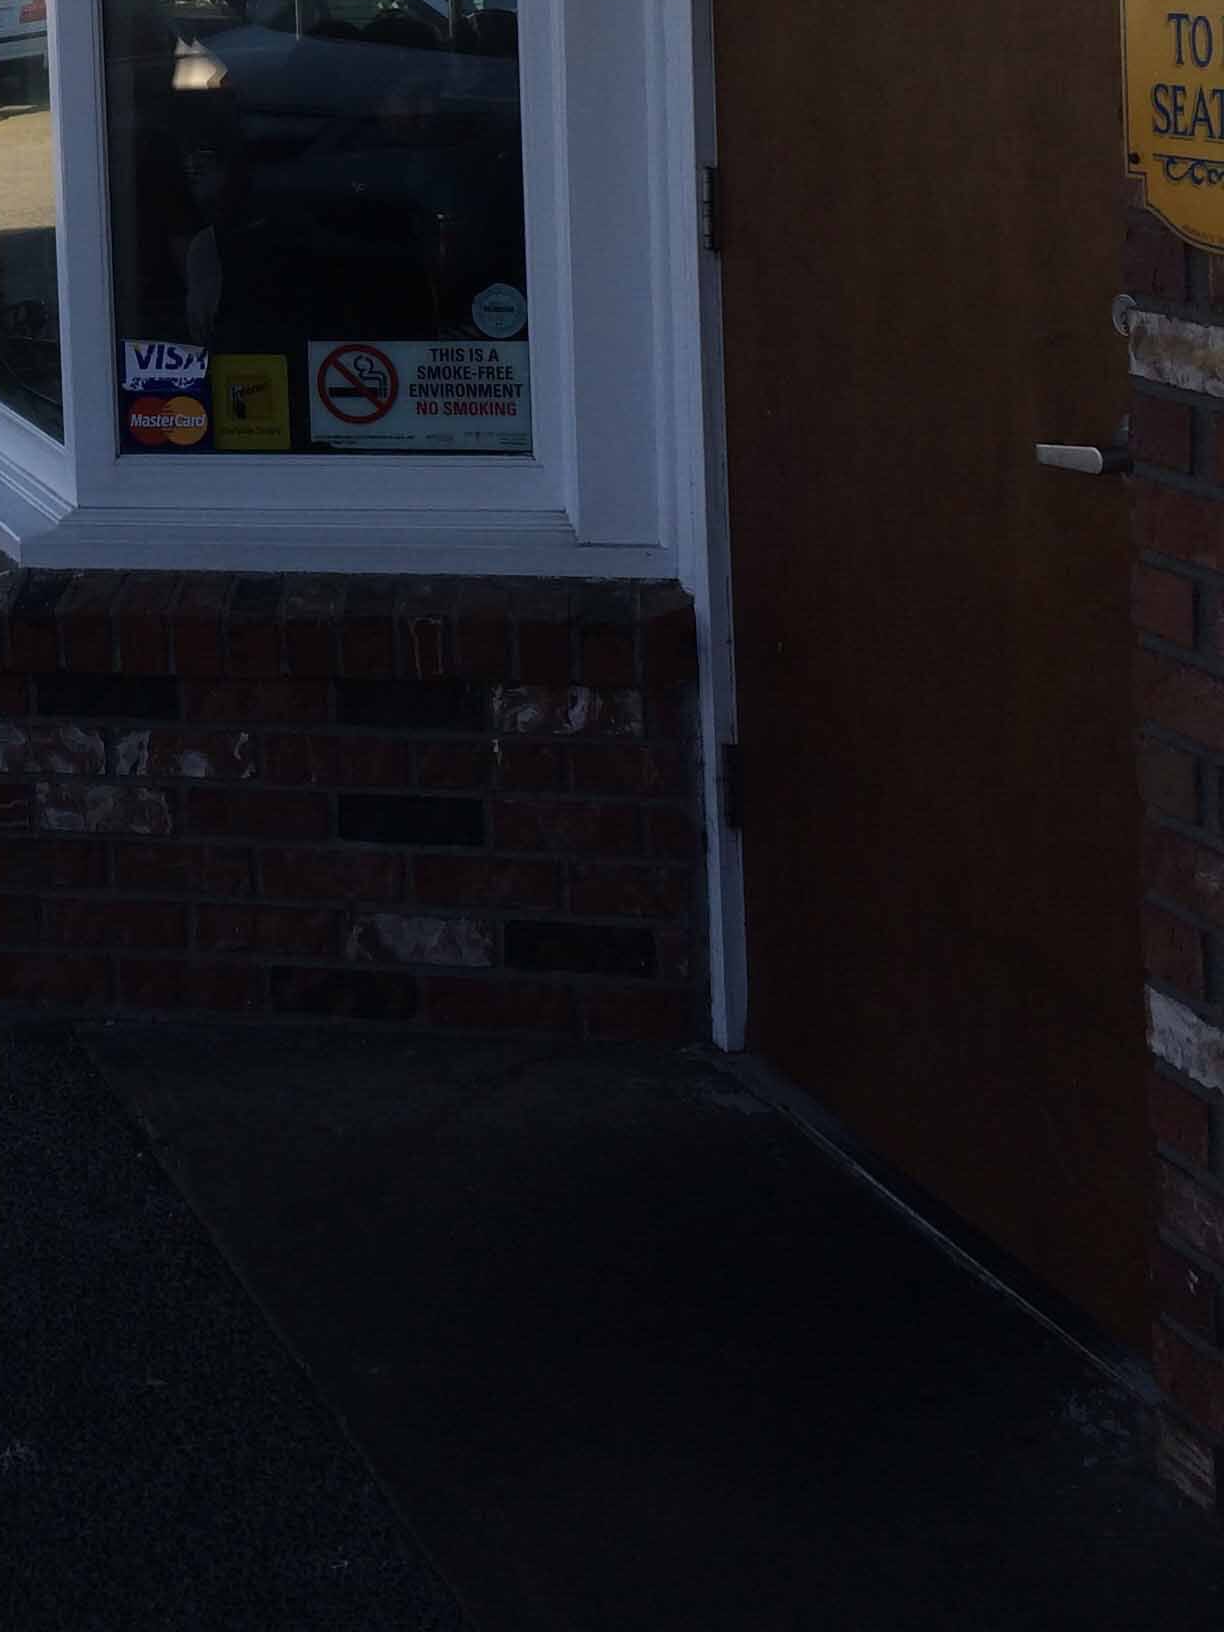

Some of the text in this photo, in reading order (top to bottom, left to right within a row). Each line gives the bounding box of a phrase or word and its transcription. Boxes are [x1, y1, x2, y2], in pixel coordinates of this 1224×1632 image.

[1167, 12, 1214, 68] TO
[134, 343, 208, 370] VISA
[430, 348, 500, 363] THIS IS A
[416, 366, 514, 380] SMOKE-FREE
[409, 383, 523, 398] ENVIRONMENT
[416, 401, 517, 416] NO SMOKING
[129, 413, 206, 428] MasterCard
